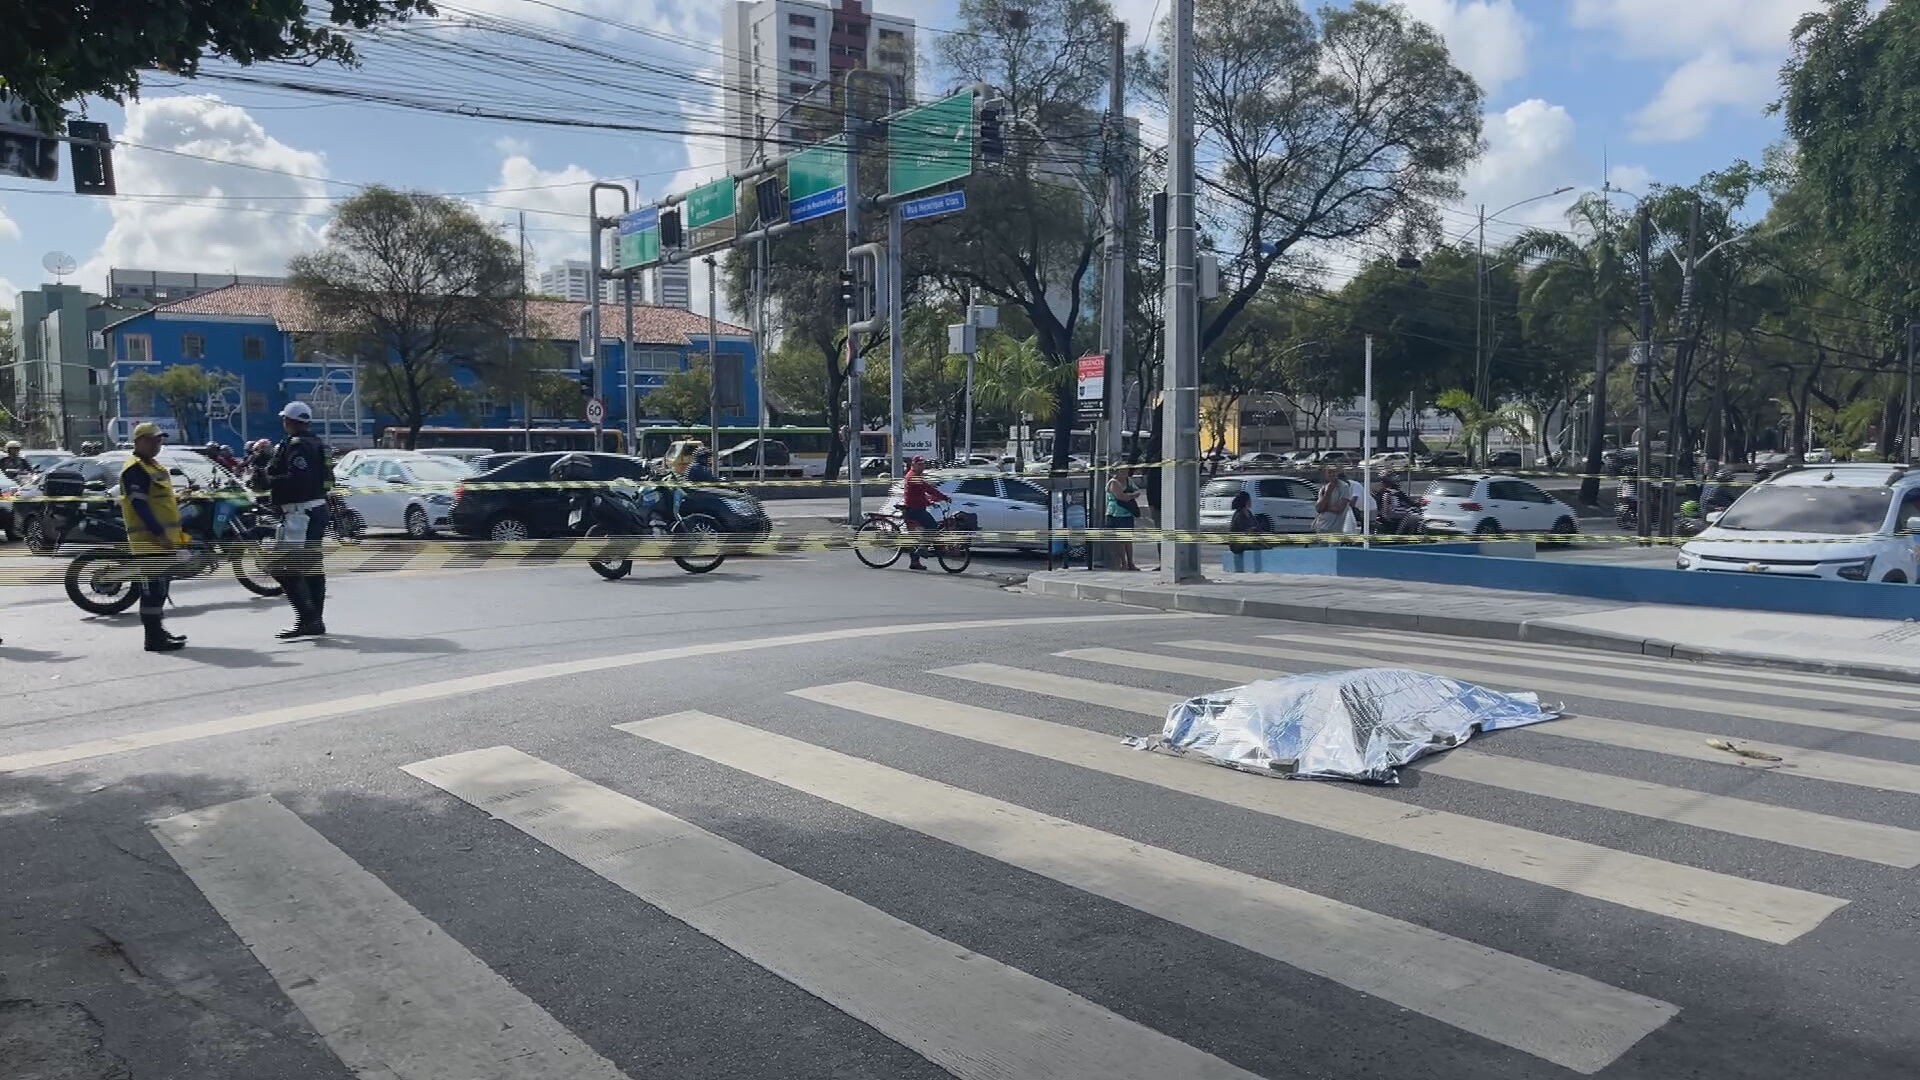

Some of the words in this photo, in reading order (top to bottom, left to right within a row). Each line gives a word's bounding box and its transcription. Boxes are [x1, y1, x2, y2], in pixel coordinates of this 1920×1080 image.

[905, 204, 918, 214] Rua
[945, 196, 960, 206] Dias
[588, 404, 602, 417] 60
[902, 440, 916, 448] ocha
[916, 440, 924, 448] de
